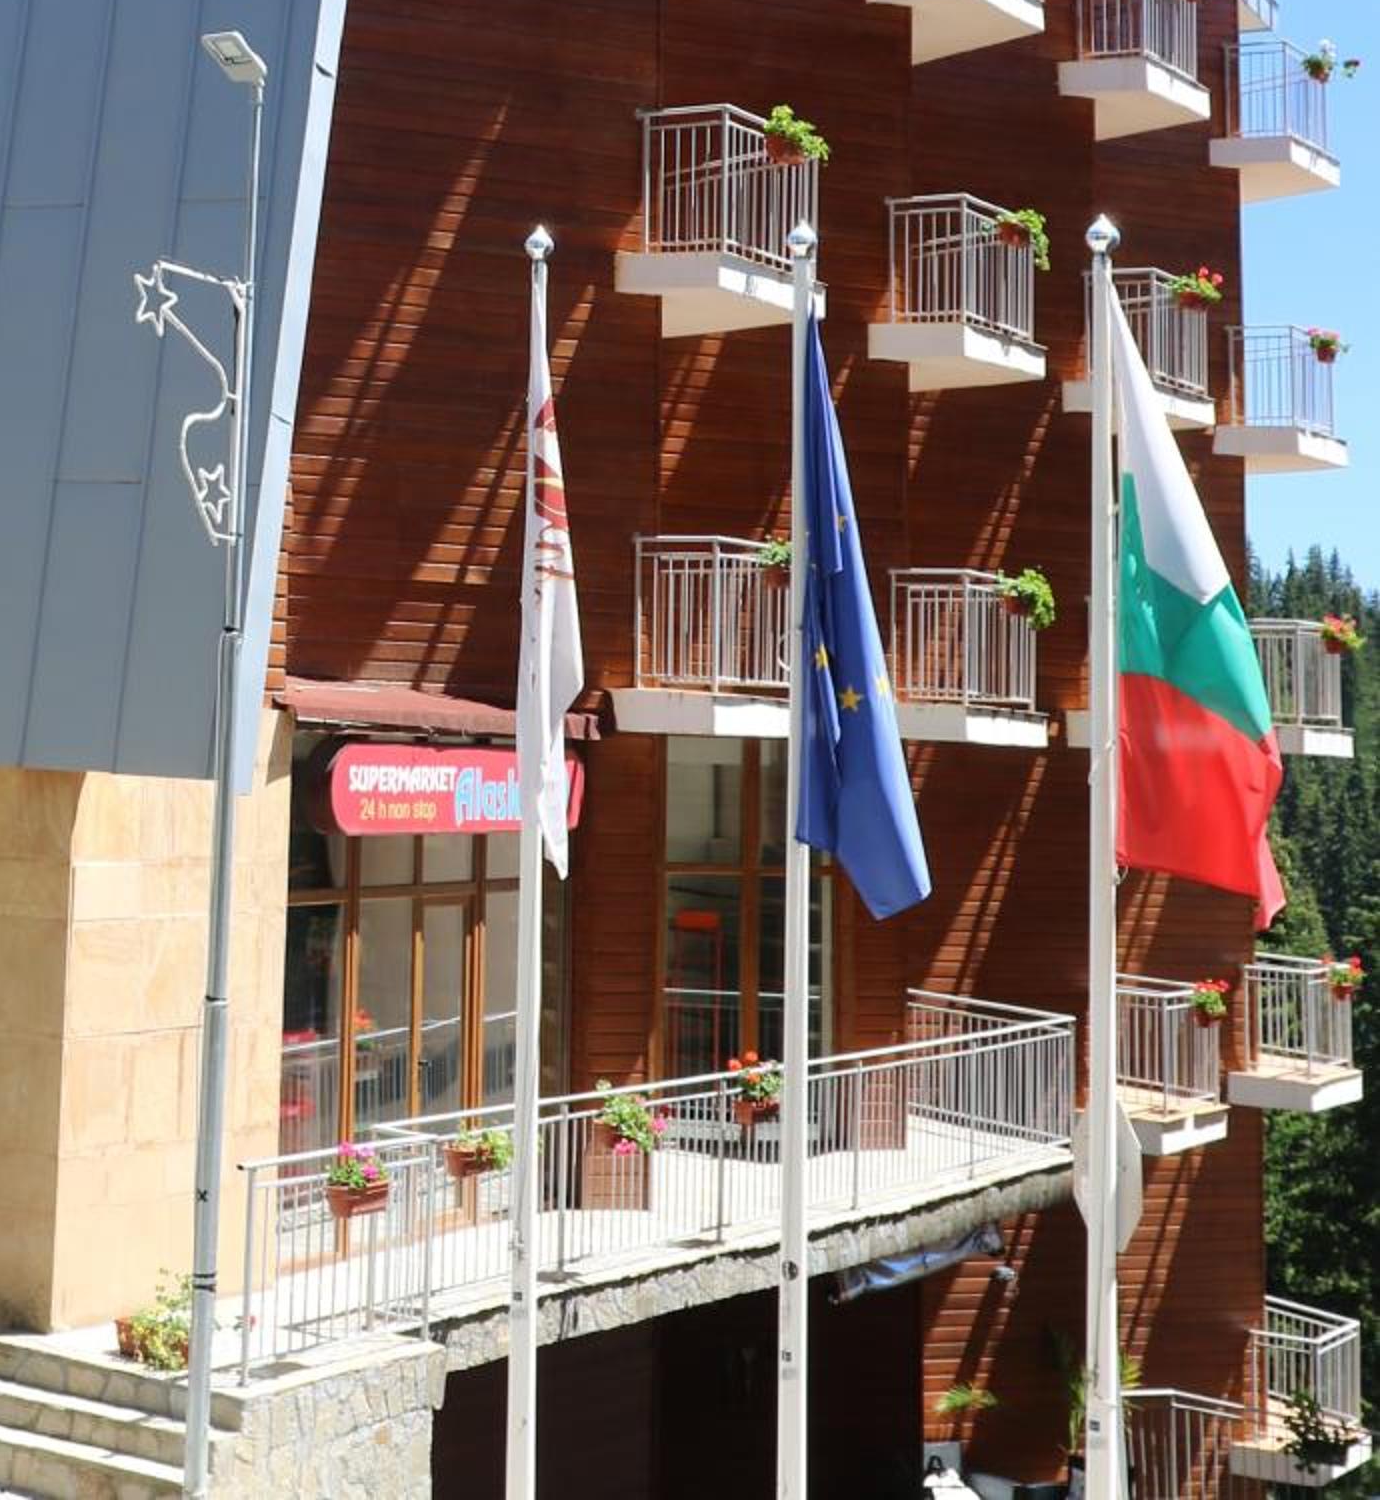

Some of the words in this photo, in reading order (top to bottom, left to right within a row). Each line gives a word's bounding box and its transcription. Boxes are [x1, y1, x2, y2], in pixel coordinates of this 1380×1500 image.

[348, 764, 458, 795] SUPERMARKET
[360, 798, 375, 821] 24
[378, 799, 387, 821] h
[388, 801, 410, 820] non
[413, 799, 437, 822] stop
[454, 766, 523, 827] Alask
